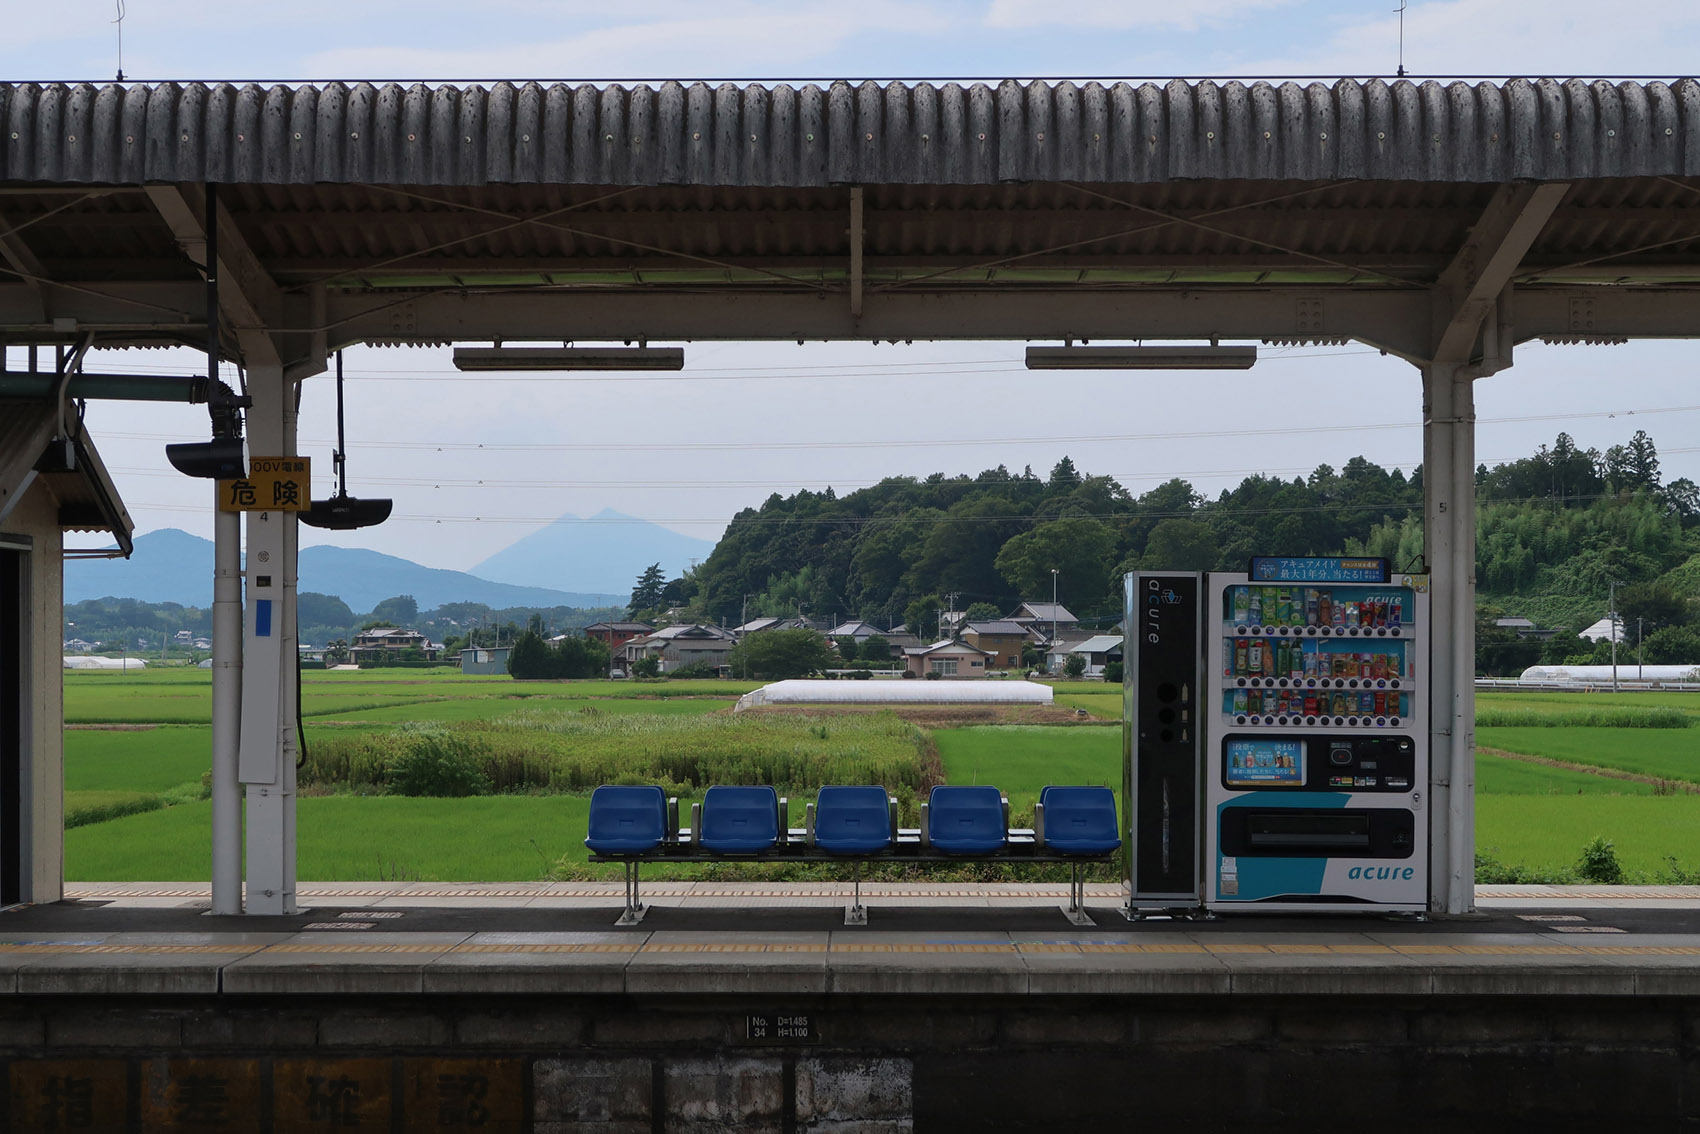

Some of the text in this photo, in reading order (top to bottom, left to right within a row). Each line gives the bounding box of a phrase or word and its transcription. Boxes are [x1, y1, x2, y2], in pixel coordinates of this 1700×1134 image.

[230, 480, 299, 506] 危険
[260, 511, 268, 522] 4
[1280, 559, 1337, 570] アキュアメイド
[1366, 596, 1402, 605] acure
[1148, 579, 1160, 644] acure
[1348, 866, 1415, 881] acure
[752, 1016, 768, 1026] No.
[754, 1027, 766, 1038] 34
